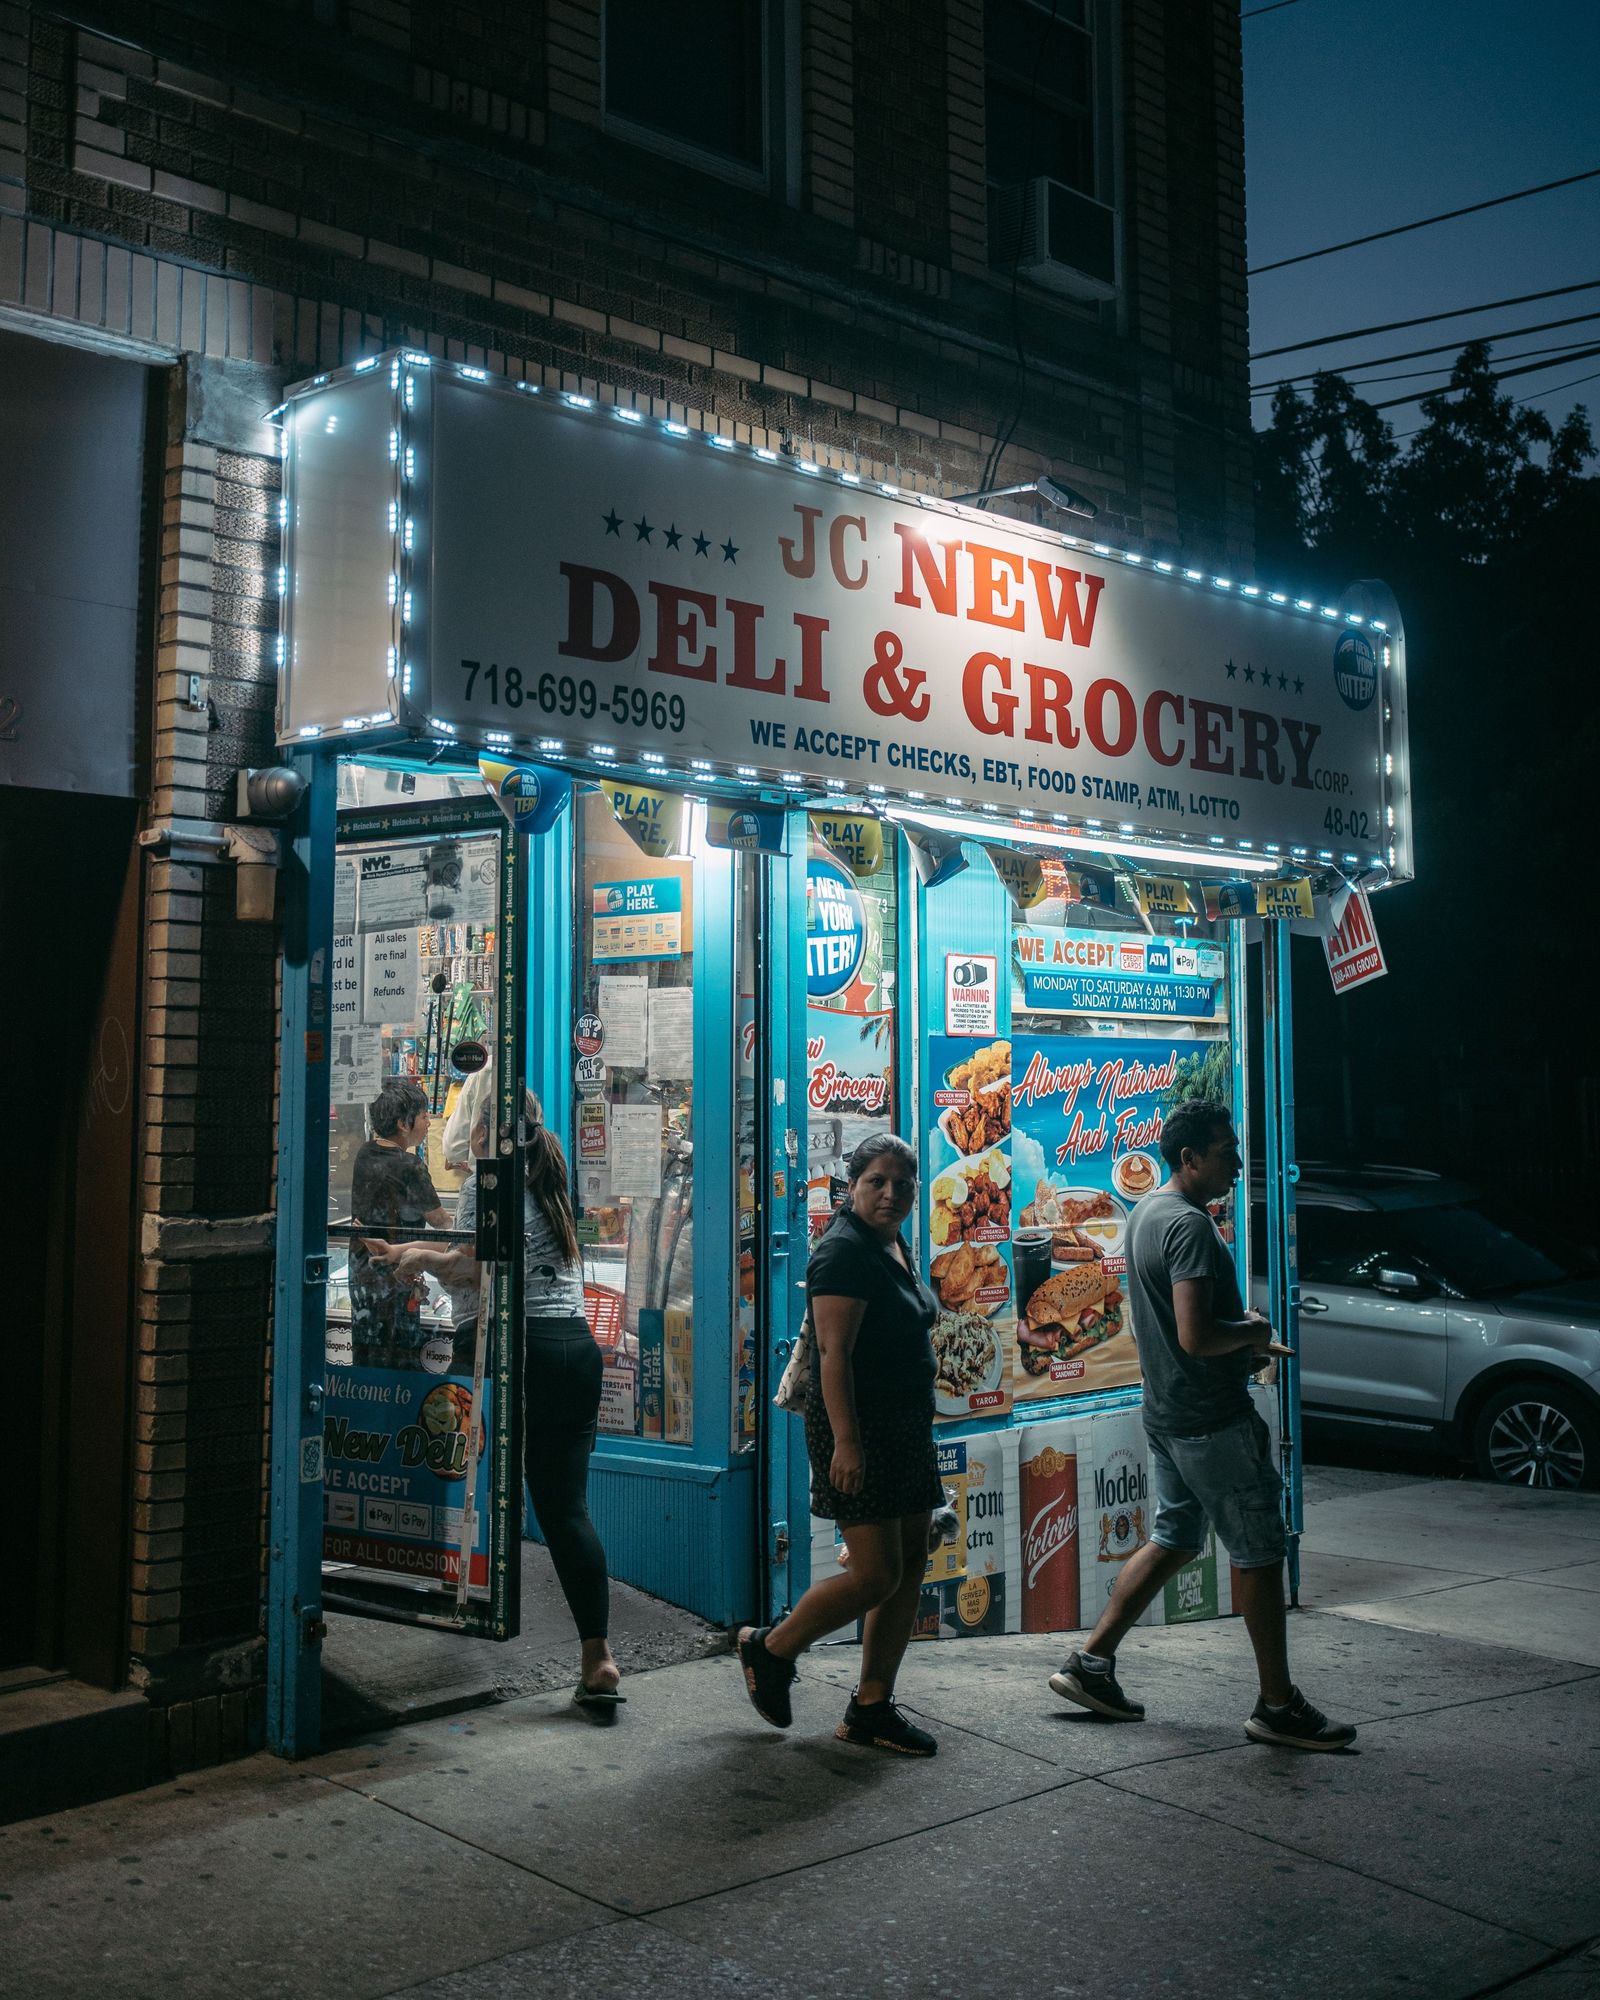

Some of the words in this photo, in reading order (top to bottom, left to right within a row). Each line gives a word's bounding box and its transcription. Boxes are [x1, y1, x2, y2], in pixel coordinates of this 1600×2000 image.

[778, 503, 869, 591] JC
[893, 522, 1106, 648] NEW
[557, 561, 832, 704] DELI
[862, 631, 931, 722] &
[961, 651, 1322, 791] GROCERY
[1336, 671, 1376, 701] LOTTERY
[460, 659, 686, 733] 718-699-5969
[750, 719, 786, 749] WE
[793, 726, 880, 764] ACCEPT
[887, 742, 977, 784] CHECKS,
[982, 758, 1023, 791] EBT,
[1028, 766, 1077, 796] FOOD
[1081, 774, 1143, 811] STAMP,
[1147, 786, 1185, 815] ATM,
[1189, 793, 1241, 821] LOTTO
[521, 773, 536, 785] NEW
[1314, 767, 1354, 796] CORP.
[521, 783, 538, 797] YORK
[613, 791, 664, 819] PLAY
[352, 820, 381, 832] Heineken
[391, 816, 421, 828] Heineken
[432, 812, 463, 824] Heineken
[1324, 805, 1369, 840] 48-02
[637, 820, 667, 845] RE.
[822, 821, 865, 843] PLAY
[362, 855, 391, 872] NYC
[849, 845, 874, 865] RE.
[626, 884, 654, 898] PLAY
[815, 876, 846, 901] NEW
[1145, 882, 1175, 902] PLAY
[1266, 886, 1298, 903] PLAY
[626, 897, 659, 911] HERE.
[818, 901, 855, 932] YORK
[1327, 890, 1372, 961] ATM
[375, 934, 386, 944] All
[387, 932, 407, 943] sales
[374, 952, 388, 961] are
[389, 950, 407, 960] final
[1018, 937, 1044, 961] WE
[1052, 940, 1114, 967] ACCEPT
[1122, 954, 1142, 962] CREDIT
[1149, 952, 1168, 967] ATM
[1122, 961, 1142, 970] CARDS
[1183, 955, 1195, 970] Pay
[1356, 953, 1378, 974] GROUP
[384, 969, 396, 979] No
[344, 979, 357, 990] be
[373, 986, 405, 997] Refunds
[1033, 976, 1079, 993] MONDAY
[1080, 979, 1094, 992] TO
[1096, 979, 1144, 995] SATURDAY
[1145, 983, 1152, 996] 6
[1174, 985, 1195, 999] 11:30
[1196, 987, 1210, 1000] PM
[952, 988, 990, 1003] WARNING
[1072, 992, 1111, 1008] SUNDAY
[1113, 995, 1119, 1008] 7
[1162, 999, 1177, 1012] PM
[579, 1018, 593, 1028] GOT
[582, 1028, 591, 1038] ID
[578, 1059, 593, 1071] GOT
[808, 1062, 886, 1110] Grocery
[1012, 1050, 1096, 1116] Always
[1097, 1049, 1177, 1114] Natural
[584, 1127, 601, 1137] We
[1056, 1110, 1107, 1166] And
[1112, 1106, 1163, 1161] Fresh
[581, 1135, 605, 1148] Card
[1103, 1258, 1127, 1266] BREAKFA
[980, 1288, 1005, 1296] EMPANADAS
[500, 1323, 508, 1368] Heineken
[642, 1348, 652, 1388] PLAY
[652, 1342, 661, 1389] HERE.
[1055, 1369, 1080, 1378] SANDWICH
[1067, 1361, 1084, 1370] CHEESE
[325, 1373, 391, 1403] Welcome
[395, 1384, 412, 1405] to
[324, 1416, 391, 1463] New
[396, 1424, 469, 1475] Deli
[937, 1448, 957, 1461] PLAY
[499, 1449, 507, 1493] Heineken
[938, 1459, 958, 1471] HERE
[342, 1470, 410, 1496] ACCEPT
[1094, 1463, 1147, 1509] Modelo
[376, 1509, 392, 1524] Pay
[411, 1513, 426, 1529] Pay
[498, 1511, 506, 1556] Heineken
[1021, 1489, 1078, 1575] Victoria
[324, 1536, 351, 1557] FOR
[355, 1541, 383, 1563] ALL
[961, 1589, 986, 1600] CERVEZA
[1186, 1591, 1203, 1609] SAL
[967, 1607, 980, 1617] FINA
